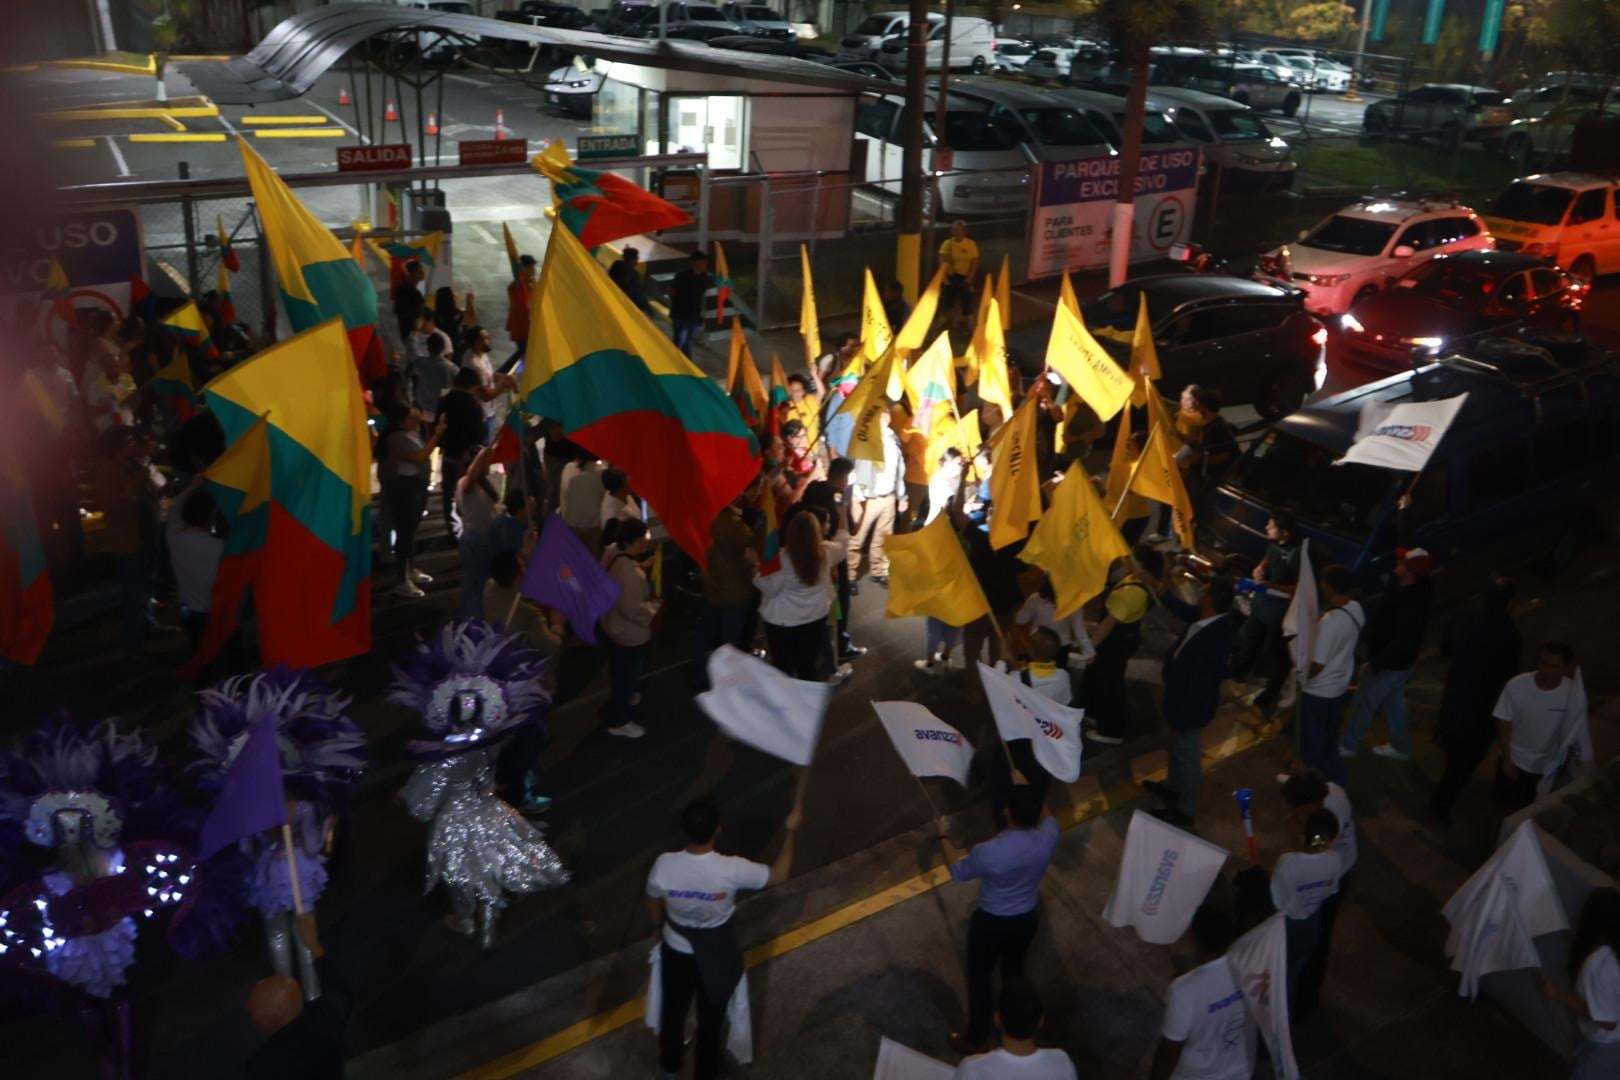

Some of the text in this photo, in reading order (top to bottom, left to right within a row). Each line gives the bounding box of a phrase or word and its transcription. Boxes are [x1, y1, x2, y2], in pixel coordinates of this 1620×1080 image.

[579, 138, 637, 153] ENTRADA
[340, 148, 408, 165] SALIDA
[1054, 151, 1193, 180] PARQUE DE USO
[1080, 173, 1167, 198] EXCLSIVO
[1045, 215, 1074, 227] PARA
[1157, 208, 1177, 239] E
[37, 221, 118, 250] USO
[1044, 224, 1094, 240] CLIENTES
